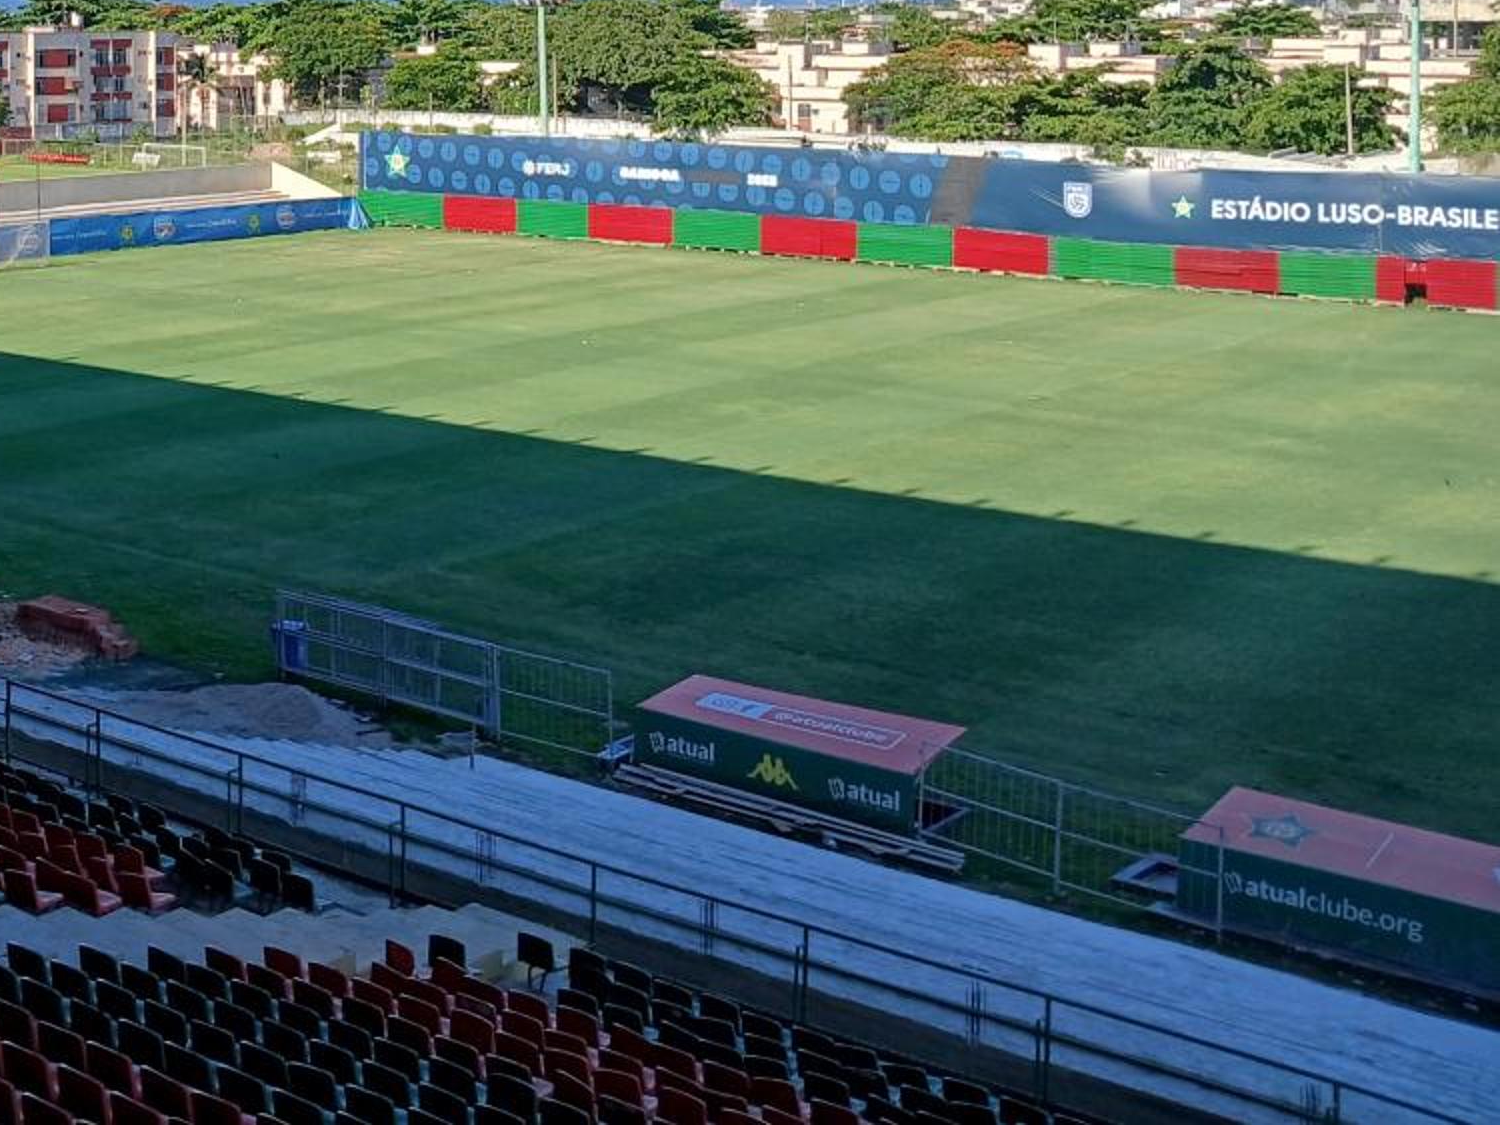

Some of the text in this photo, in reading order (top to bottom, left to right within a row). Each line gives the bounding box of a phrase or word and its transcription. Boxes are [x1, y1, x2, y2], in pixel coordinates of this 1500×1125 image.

[1211, 196, 1310, 222] ESTÁDIO
[667, 737, 715, 763] atual
[846, 784, 900, 812] atual
[1245, 876, 1424, 943] atualclube.org
